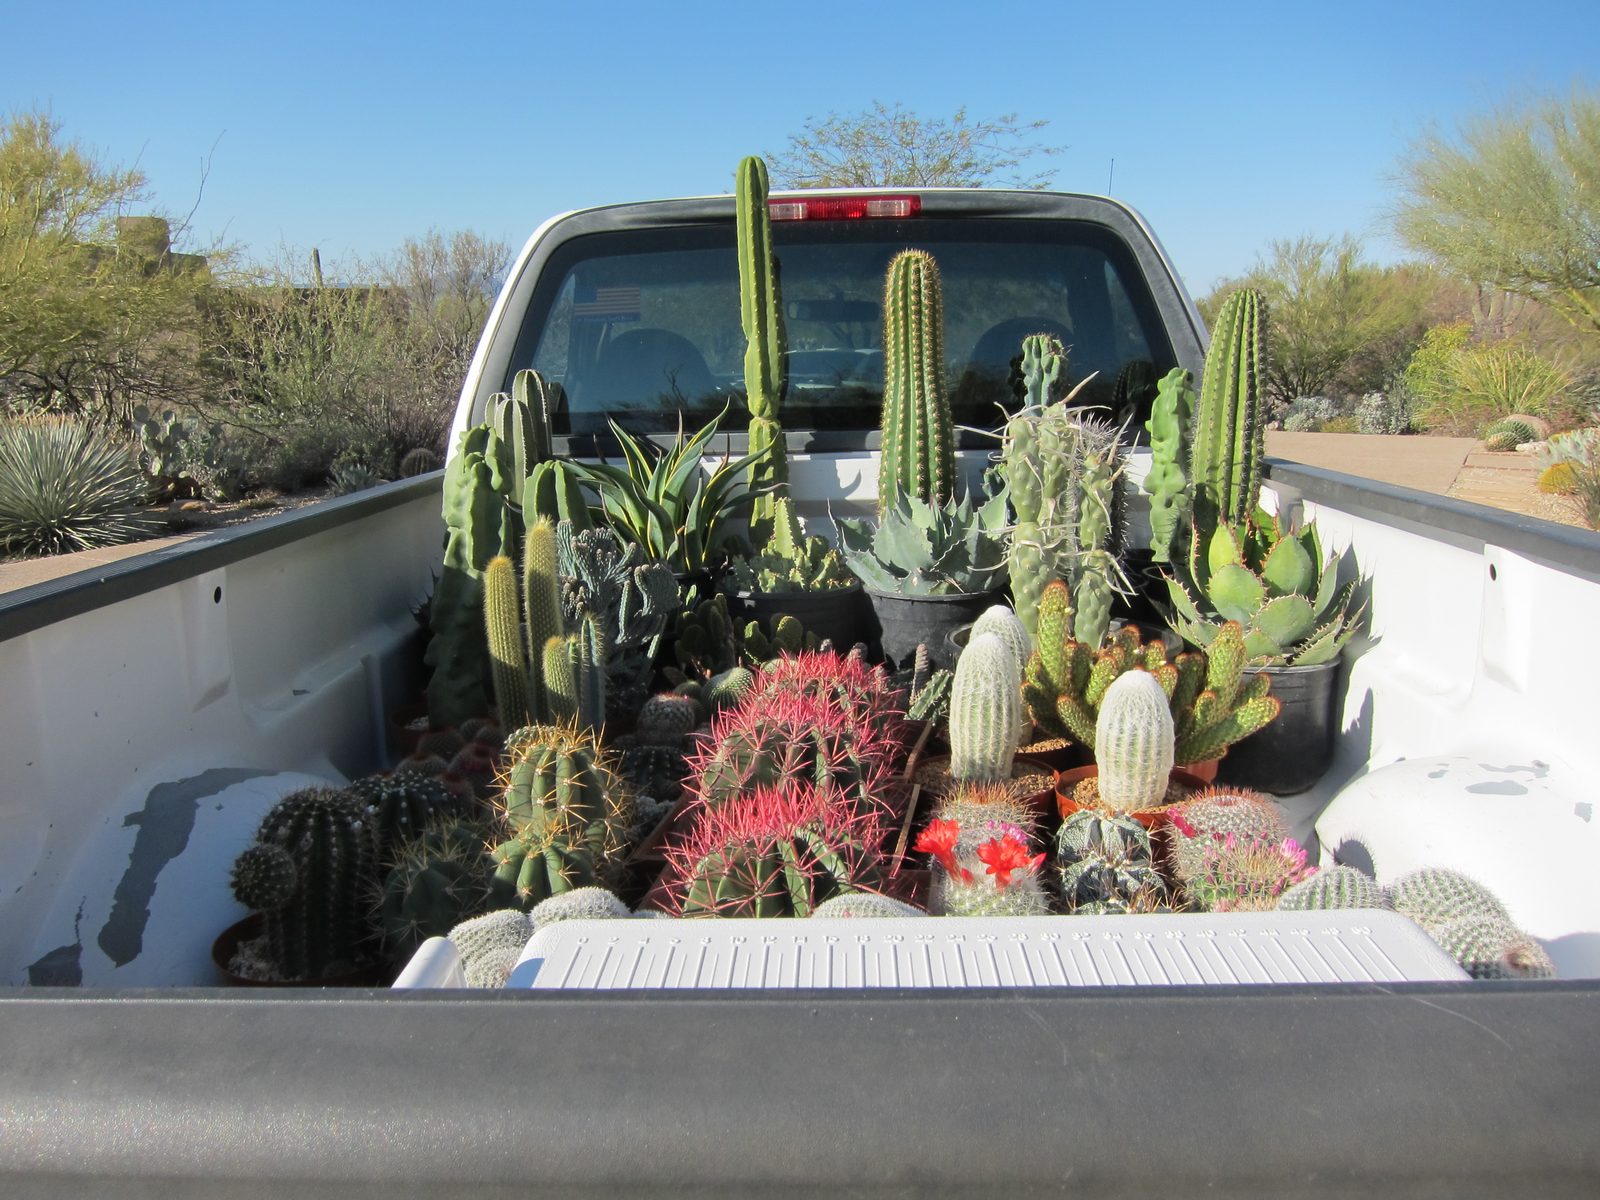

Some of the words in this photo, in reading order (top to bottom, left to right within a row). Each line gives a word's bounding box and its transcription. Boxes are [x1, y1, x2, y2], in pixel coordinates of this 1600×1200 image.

[730, 936, 747, 944] 10
[761, 936, 778, 944] 12
[854, 935, 871, 943] 18
[883, 935, 905, 943] 20
[914, 934, 935, 943] 22
